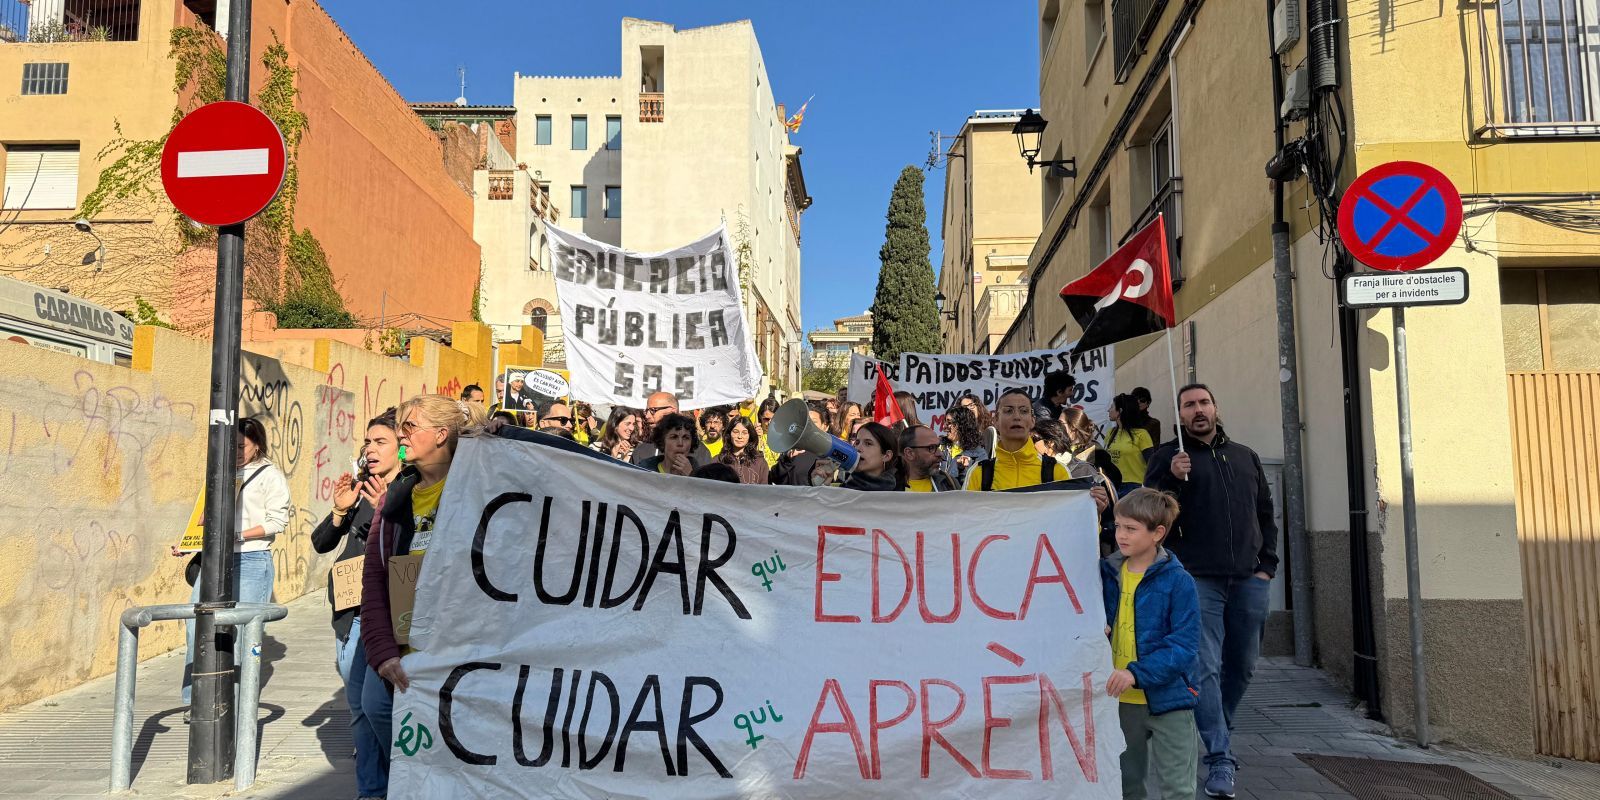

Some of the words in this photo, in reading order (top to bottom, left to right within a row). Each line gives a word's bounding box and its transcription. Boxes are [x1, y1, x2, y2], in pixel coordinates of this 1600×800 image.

[556, 236, 728, 295] EDUCACIÓ
[1353, 278, 1380, 289] Franja
[1382, 277, 1404, 286] lliure
[1406, 274, 1456, 285] d'obstacles
[34, 292, 116, 337] CABANAS
[1375, 291, 1389, 300] per
[1391, 290, 1397, 298] a
[1399, 288, 1439, 298] invidents
[575, 297, 729, 350] PÚBLICA
[471, 491, 752, 620] CUIDAR
[751, 549, 786, 592] qui
[815, 525, 1083, 624] EDUCA
[394, 712, 433, 757] és
[438, 661, 733, 779] CUIDAR
[734, 699, 783, 749] qui
[793, 642, 1098, 783] APRÈN
